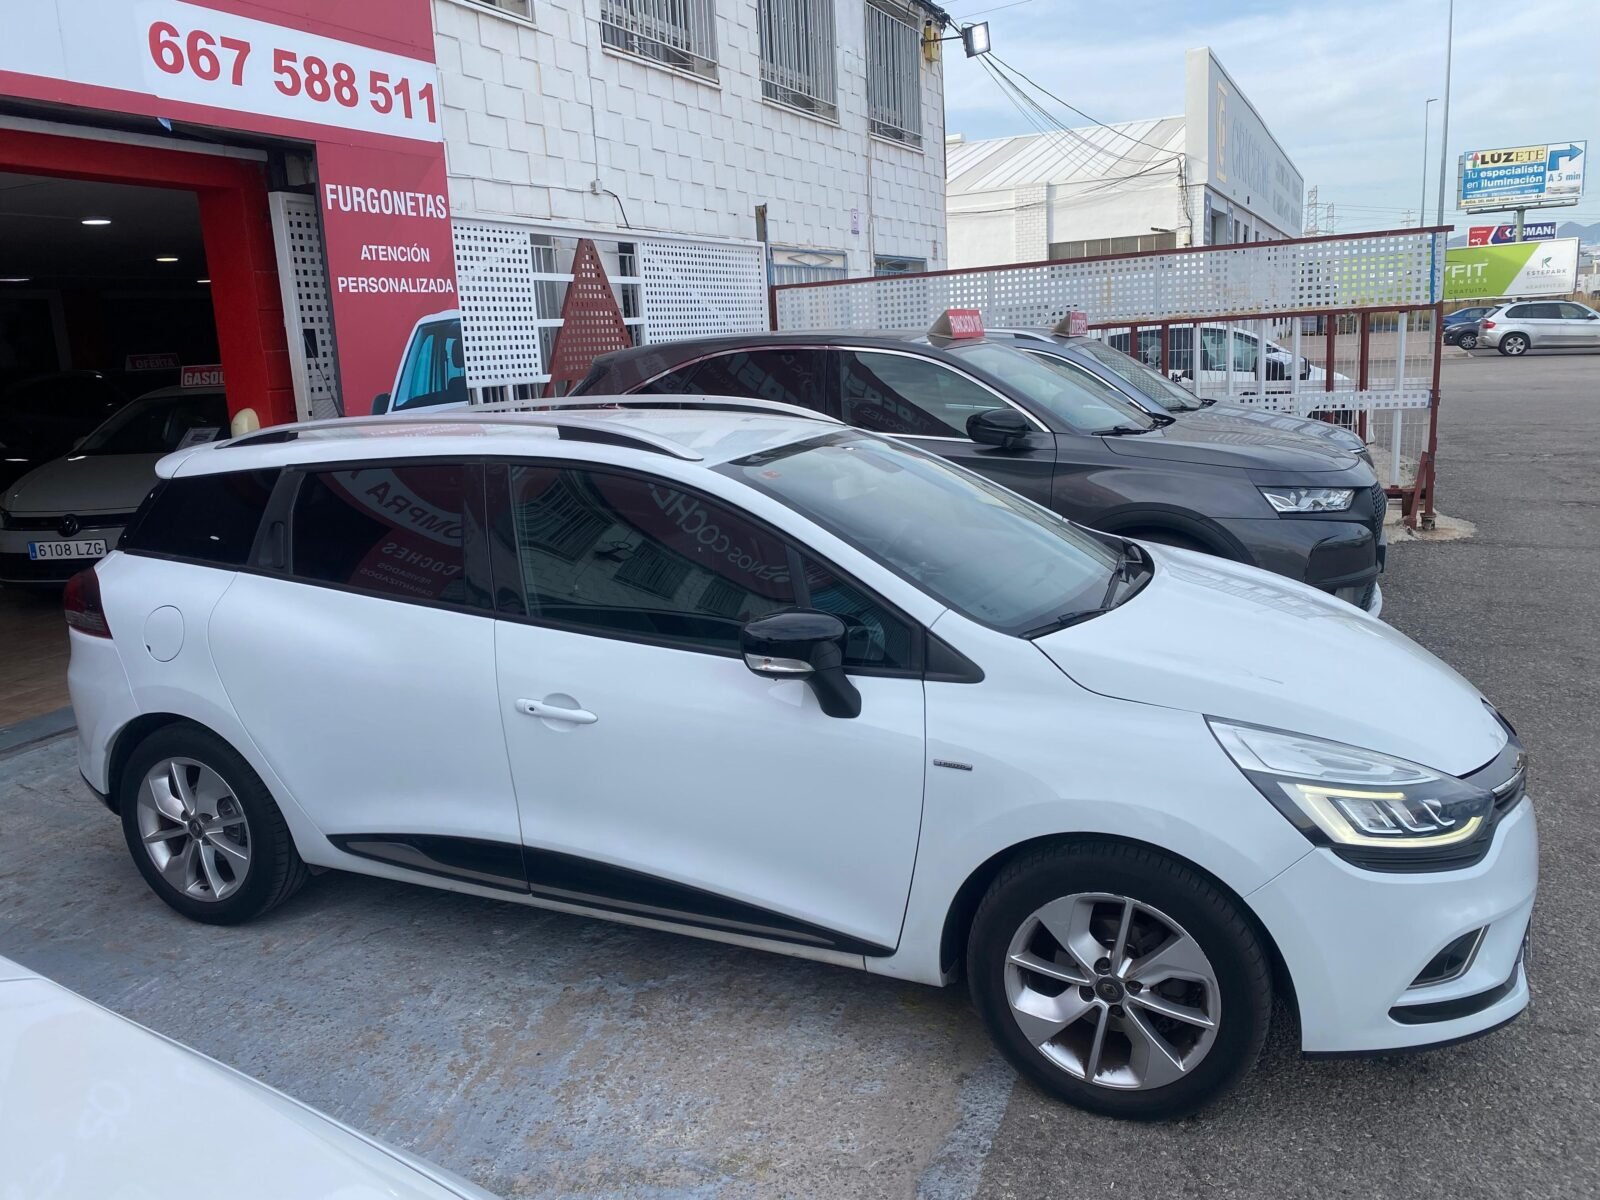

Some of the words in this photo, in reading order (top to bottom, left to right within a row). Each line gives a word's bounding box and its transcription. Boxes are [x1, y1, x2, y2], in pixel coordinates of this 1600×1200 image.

[148, 20, 251, 87] 667
[272, 48, 360, 109] 588
[369, 69, 437, 124] 511
[1466, 170, 1478, 180] Tu
[1480, 165, 1544, 178] especialista
[1547, 173, 1555, 182] A
[1557, 172, 1563, 181] 5
[1566, 172, 1581, 181] min
[1466, 181, 1479, 189] en
[1480, 175, 1543, 188] iluminación
[324, 183, 447, 220] FURGONETAS
[360, 243, 431, 263] ATENCIÓN
[337, 276, 455, 294] PERSONALIZADA
[135, 358, 176, 369] OFERTA
[184, 371, 225, 386] GASOL
[38, 543, 73, 557] 6108
[76, 542, 104, 556] LZG
